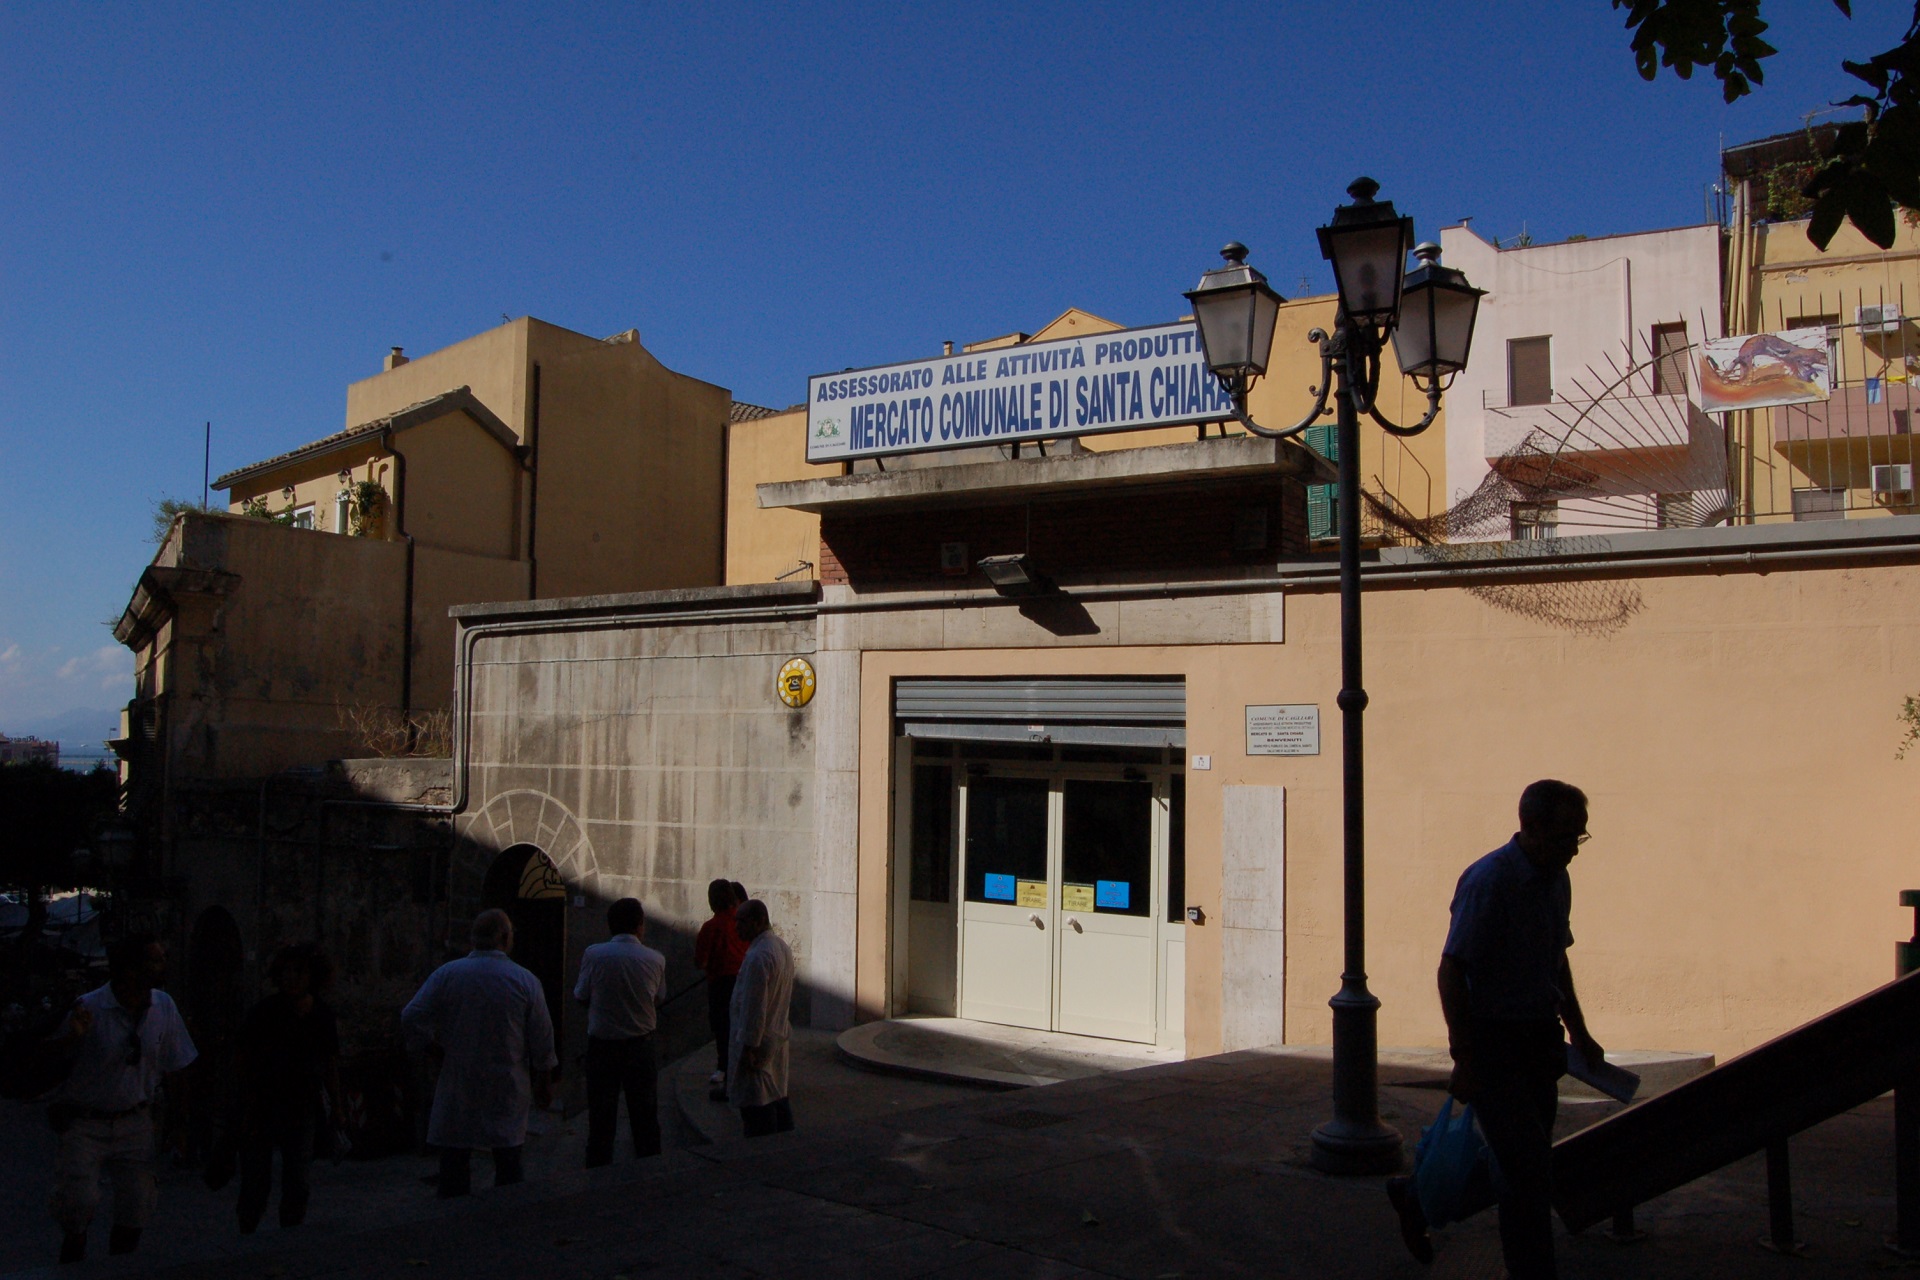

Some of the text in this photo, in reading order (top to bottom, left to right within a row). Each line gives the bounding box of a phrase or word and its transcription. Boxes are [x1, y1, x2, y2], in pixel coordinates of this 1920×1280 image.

[816, 329, 1202, 402] ASSESSORATO ALLE ATTIVITÀ PRODUTTI
[849, 361, 1231, 450] MERCATO COMUNALE DI SANTA CHIARA
